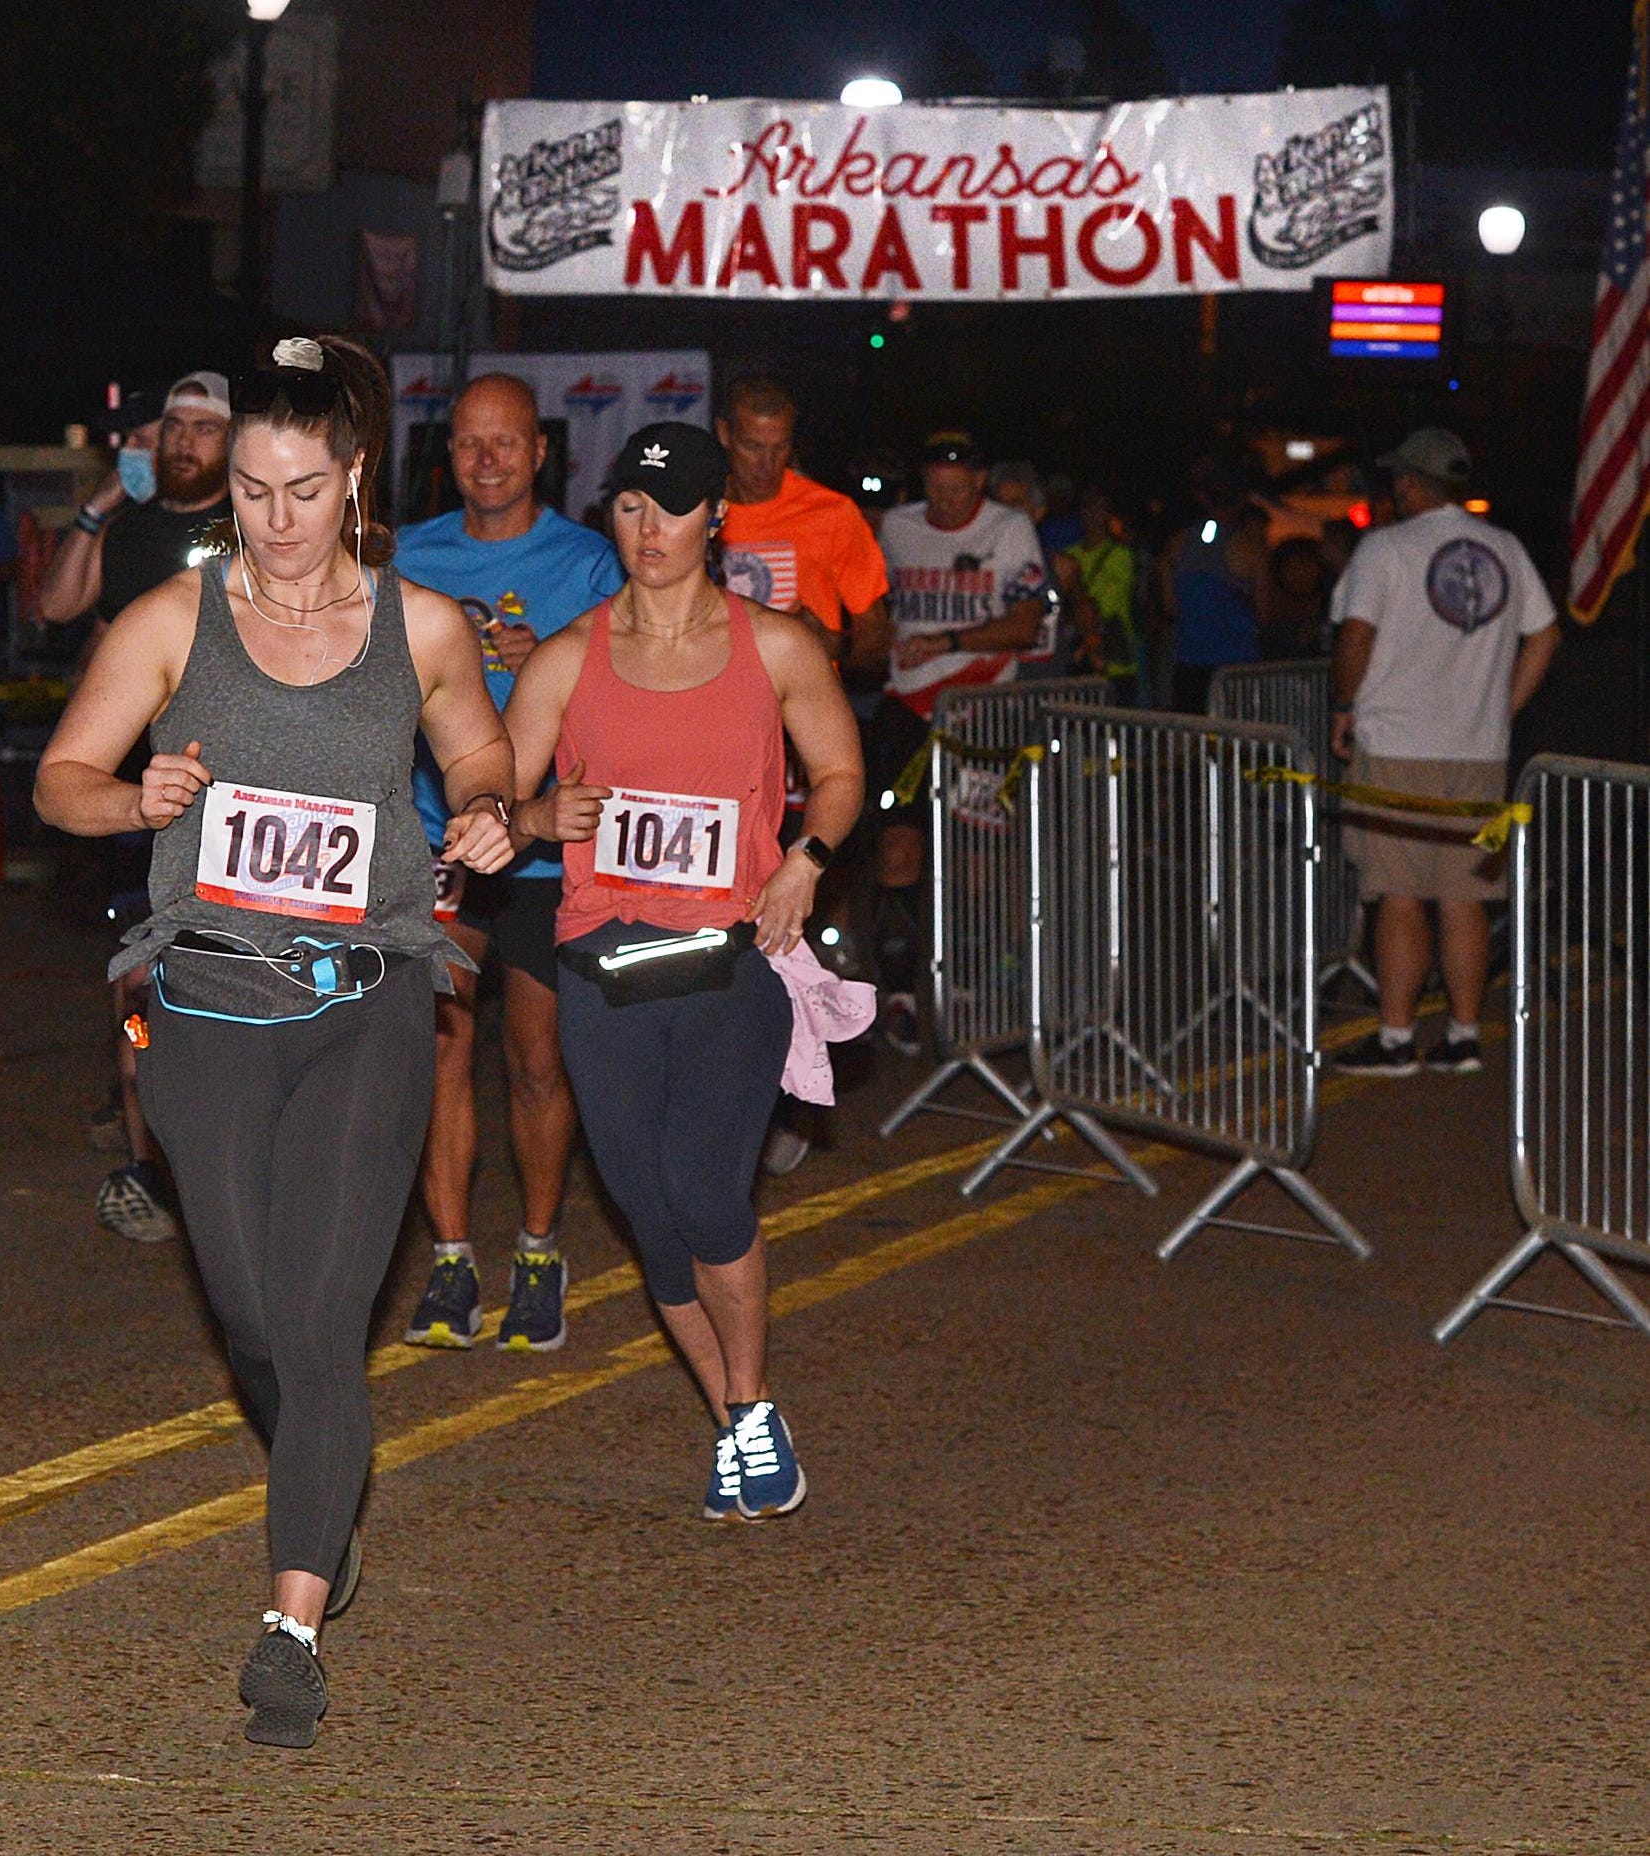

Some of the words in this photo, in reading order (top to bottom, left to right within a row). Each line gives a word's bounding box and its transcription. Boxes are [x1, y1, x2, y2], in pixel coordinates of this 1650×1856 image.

[703, 116, 1140, 198] Arkansas
[624, 195, 1240, 290] MARATHON
[225, 810, 360, 895] 1042
[614, 810, 722, 877] 1041
